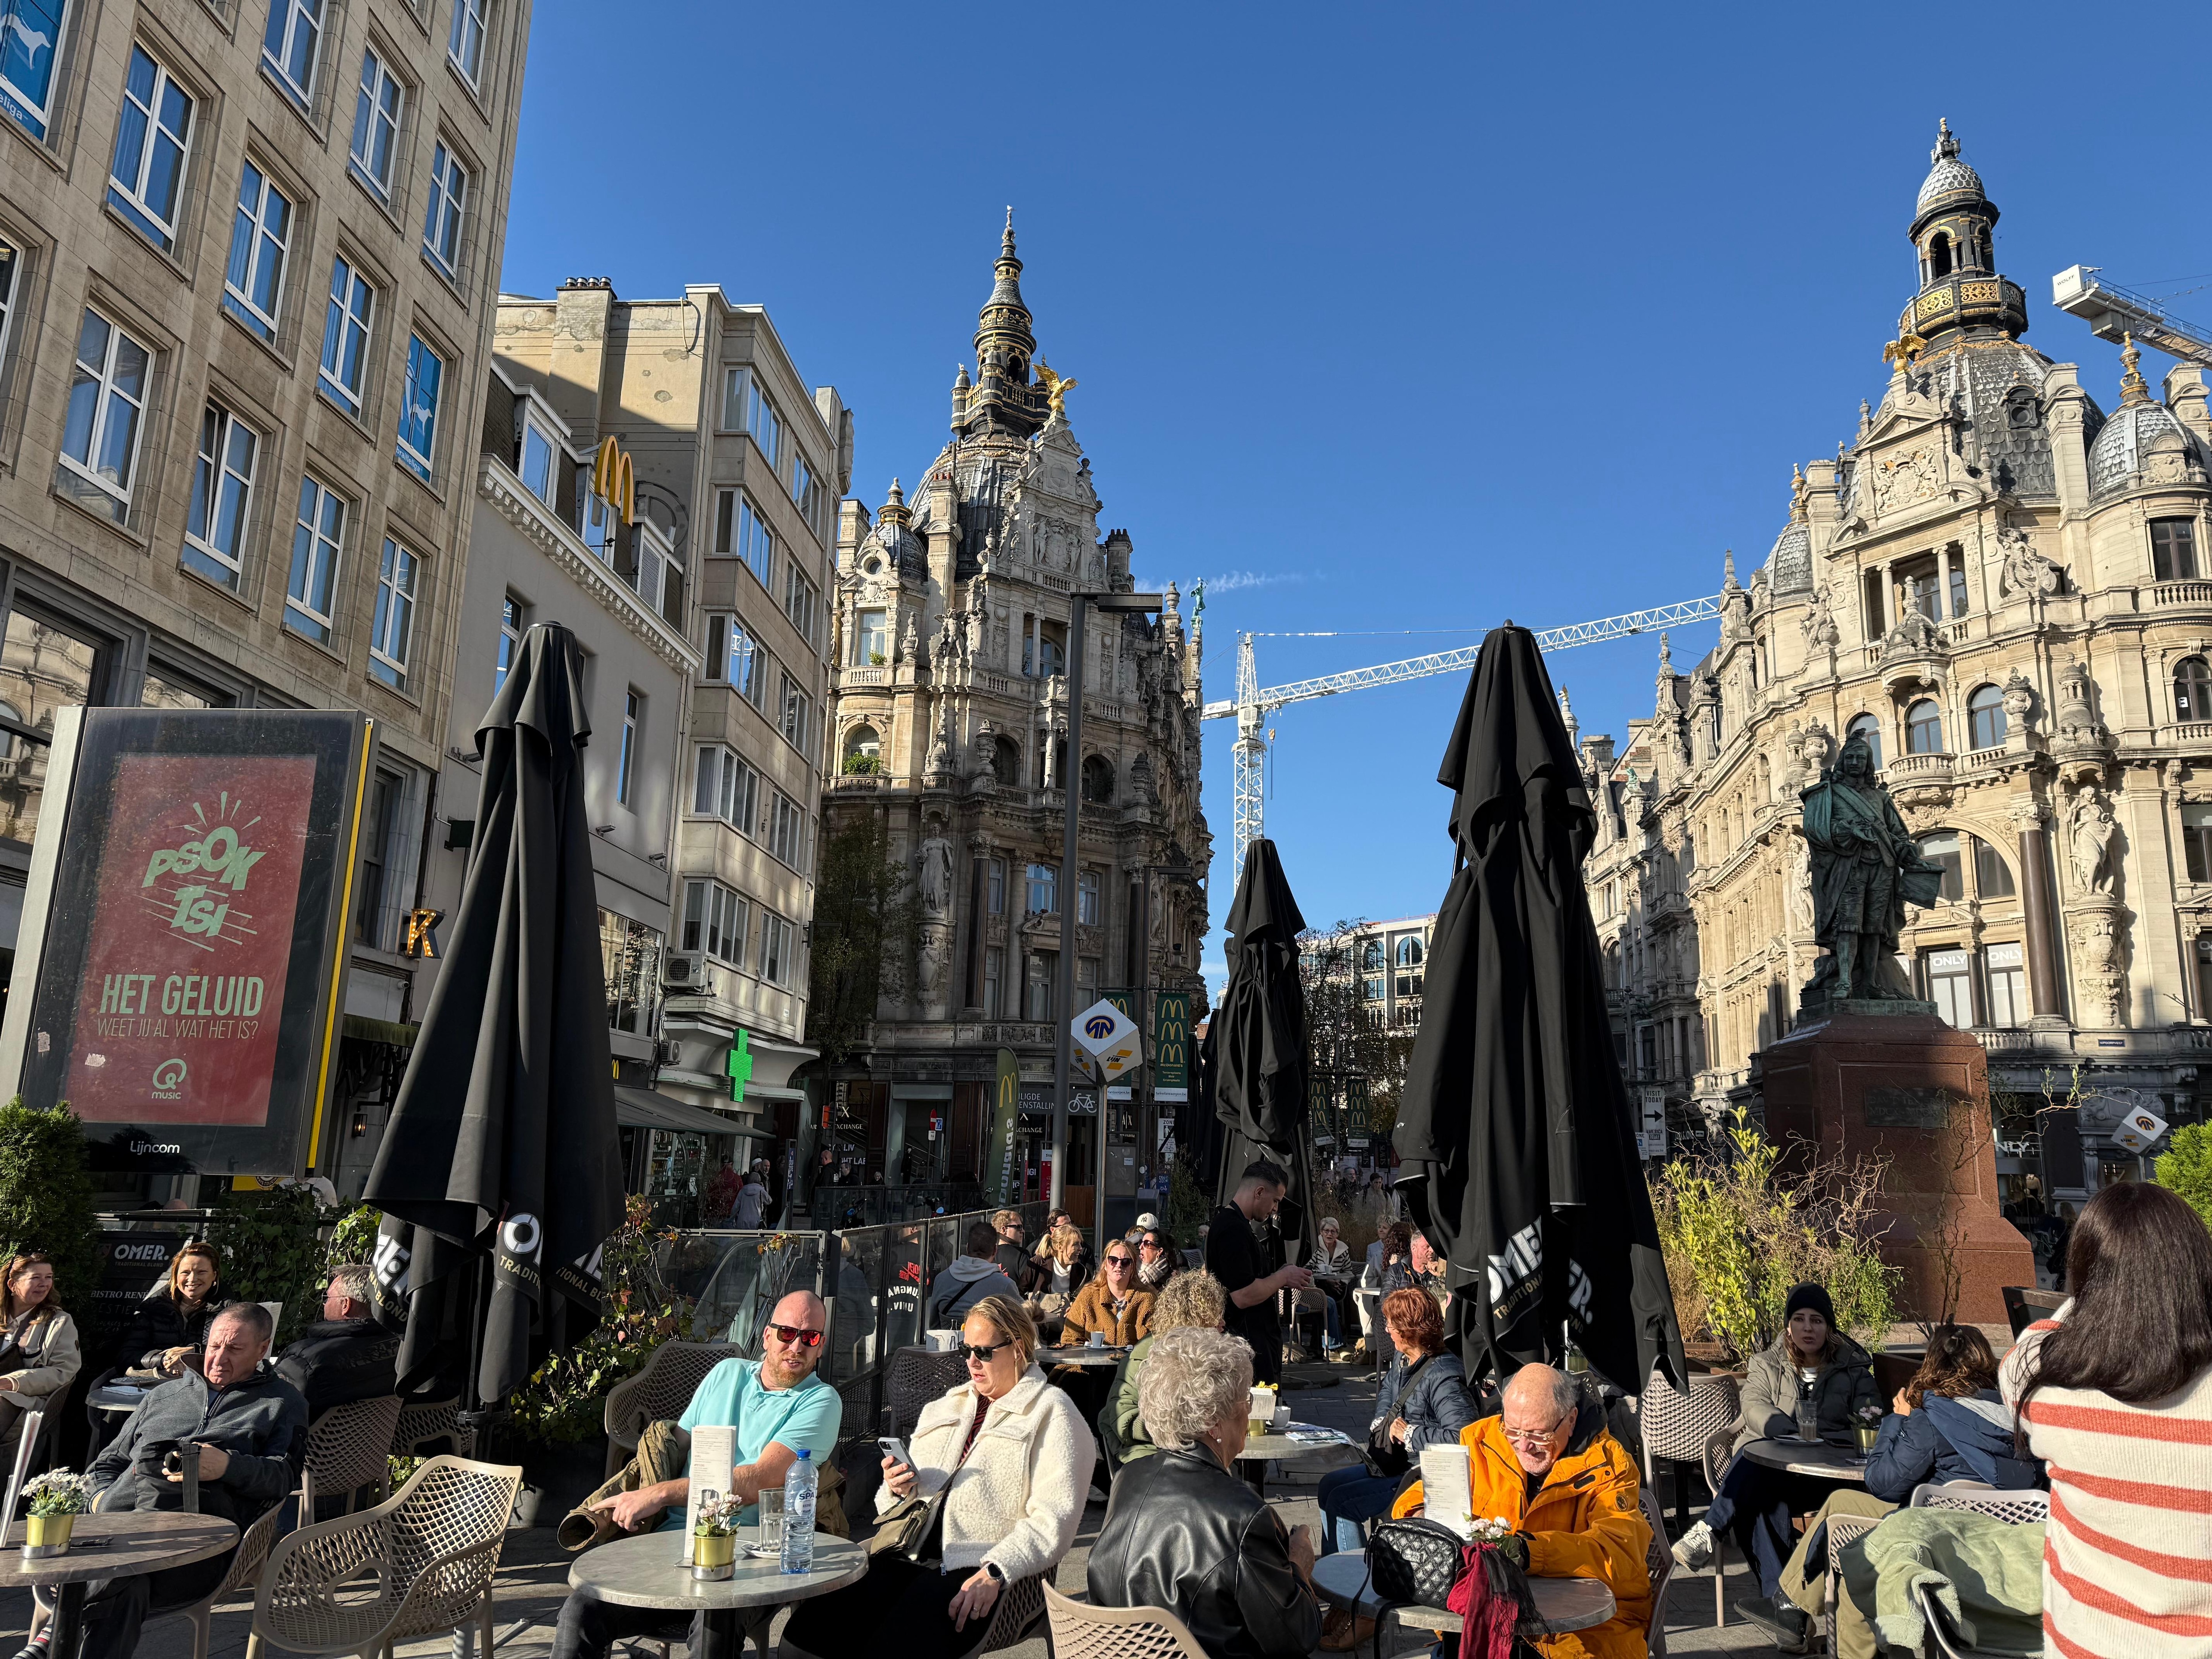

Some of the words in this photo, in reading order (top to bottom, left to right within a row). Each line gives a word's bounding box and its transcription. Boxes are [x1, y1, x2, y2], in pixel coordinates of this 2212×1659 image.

[170, 885, 229, 937] TSI
[1933, 955, 1967, 967] ONLY
[100, 974, 156, 1014] HET
[161, 975, 264, 1016] GELUID
[98, 1018, 135, 1037] WEET
[137, 1018, 151, 1037] JIJ
[154, 1019, 169, 1037] AL
[176, 1019, 206, 1038] WAT
[209, 1020, 235, 1038] HET
[238, 1021, 258, 1039] IS?
[130, 1141, 180, 1155] Lijncom
[90, 1290, 123, 1299] BISTRO
[1494, 1271, 1543, 1320] TRADITIONA
[375, 1290, 409, 1322] BLOND
[799, 1492, 814, 1500] SPA
